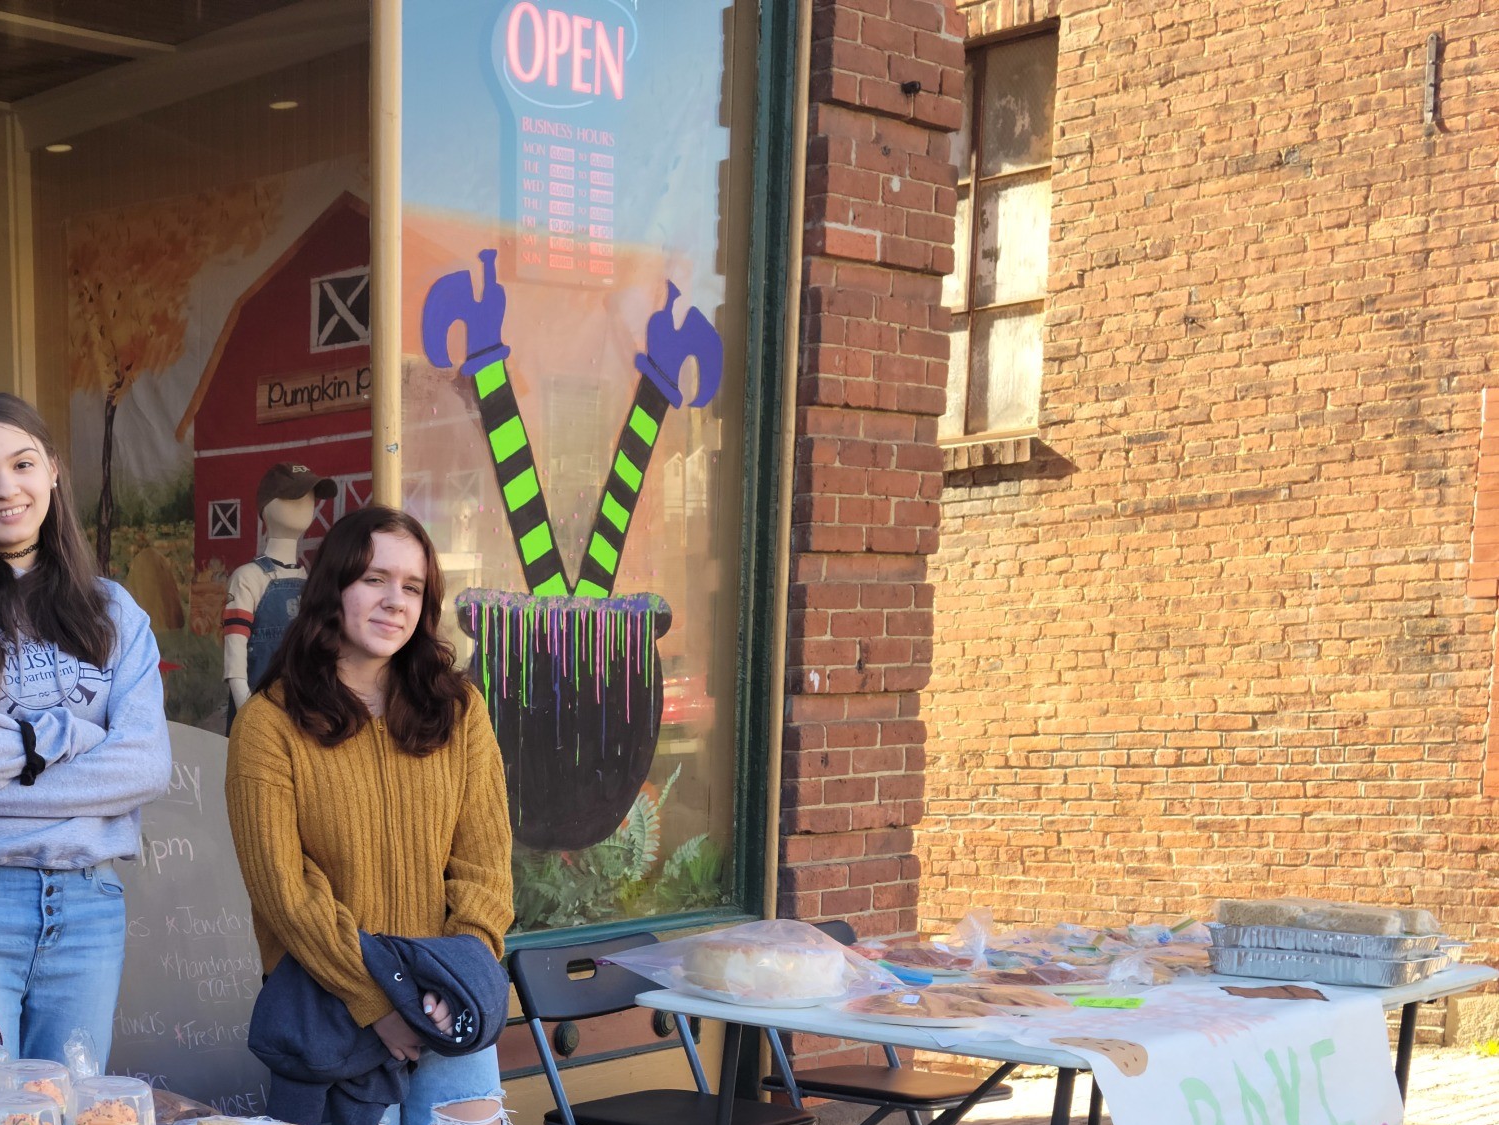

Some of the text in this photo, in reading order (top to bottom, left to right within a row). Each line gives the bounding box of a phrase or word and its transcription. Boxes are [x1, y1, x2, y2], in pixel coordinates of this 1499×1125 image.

[507, 1, 625, 100] OPEN
[521, 116, 615, 147] BUSINESS HOURS
[522, 141, 546, 156] MON
[267, 375, 350, 412] Pumpkin
